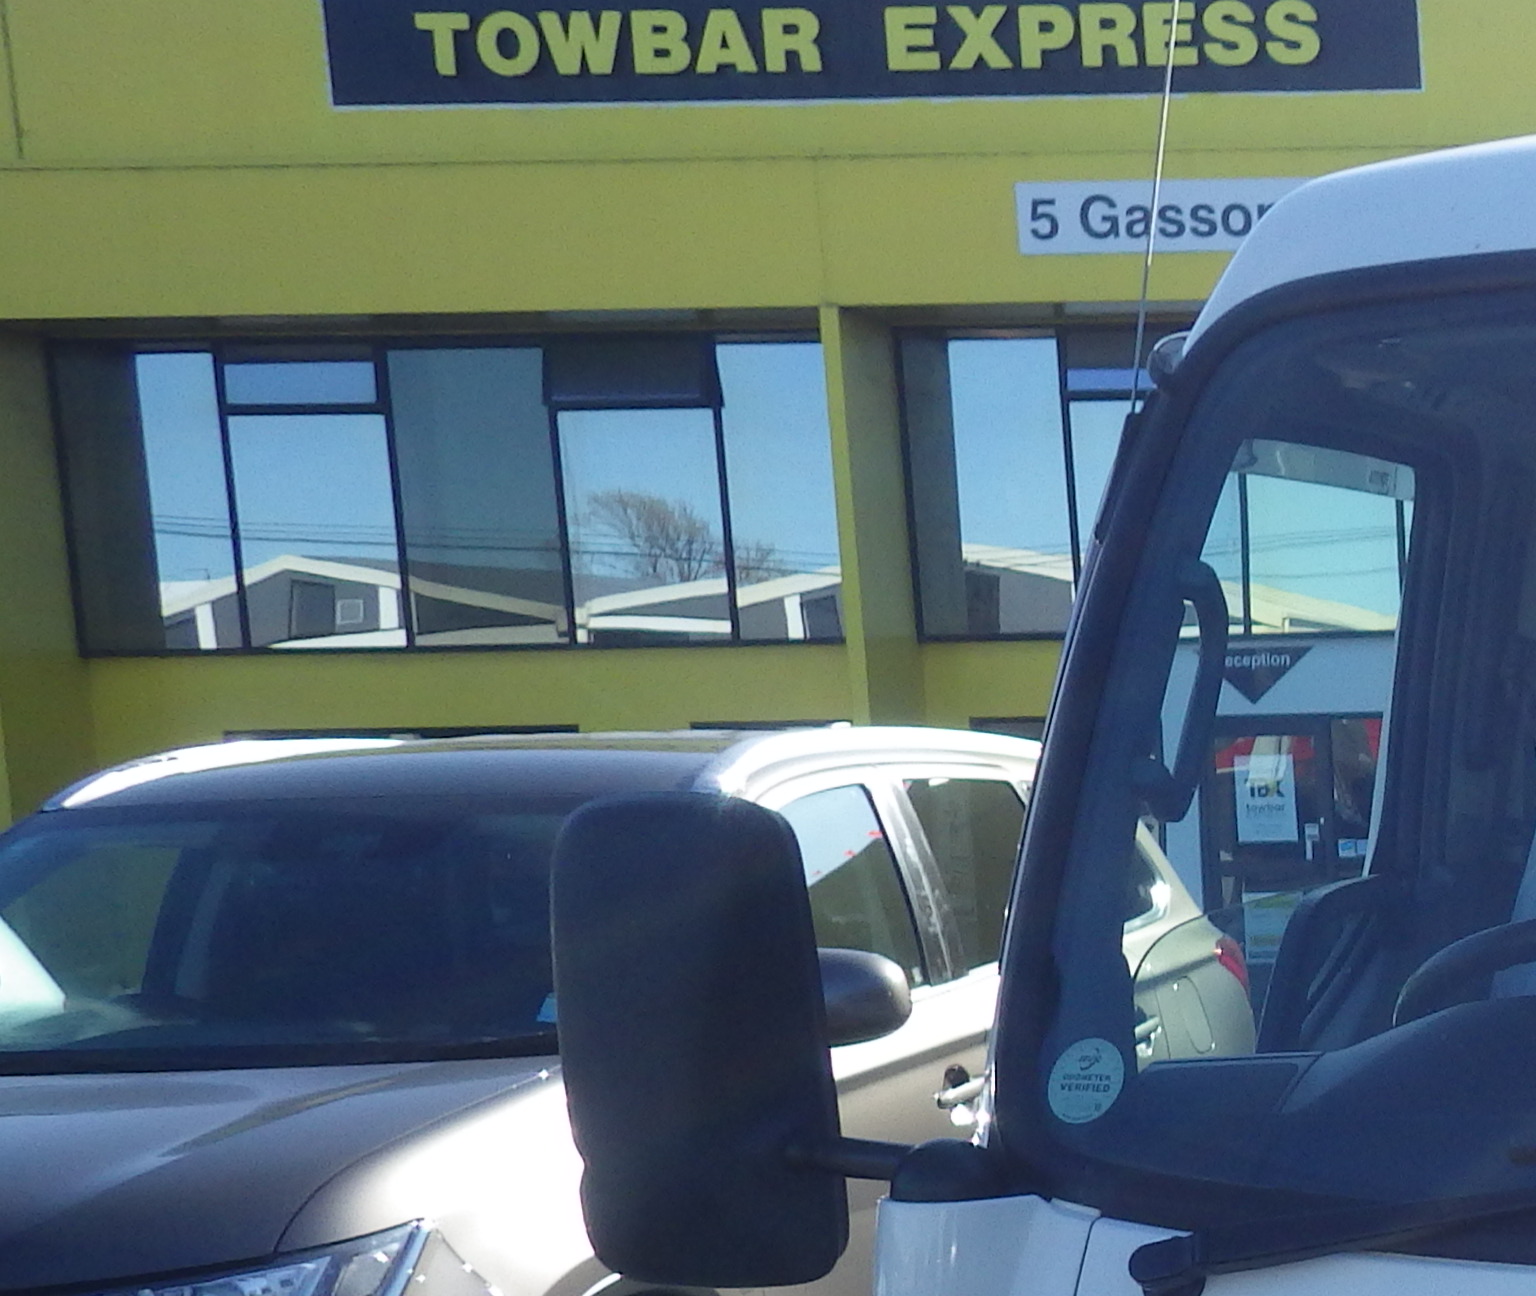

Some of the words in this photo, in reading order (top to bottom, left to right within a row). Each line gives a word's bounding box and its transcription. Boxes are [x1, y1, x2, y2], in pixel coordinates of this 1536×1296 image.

[414, 8, 822, 77] TOWBAR
[885, 0, 1322, 72] EXPRESS
[1028, 197, 1059, 240] 5
[1225, 653, 1291, 670] eception
[1060, 1083, 1111, 1093] VERIFIED
